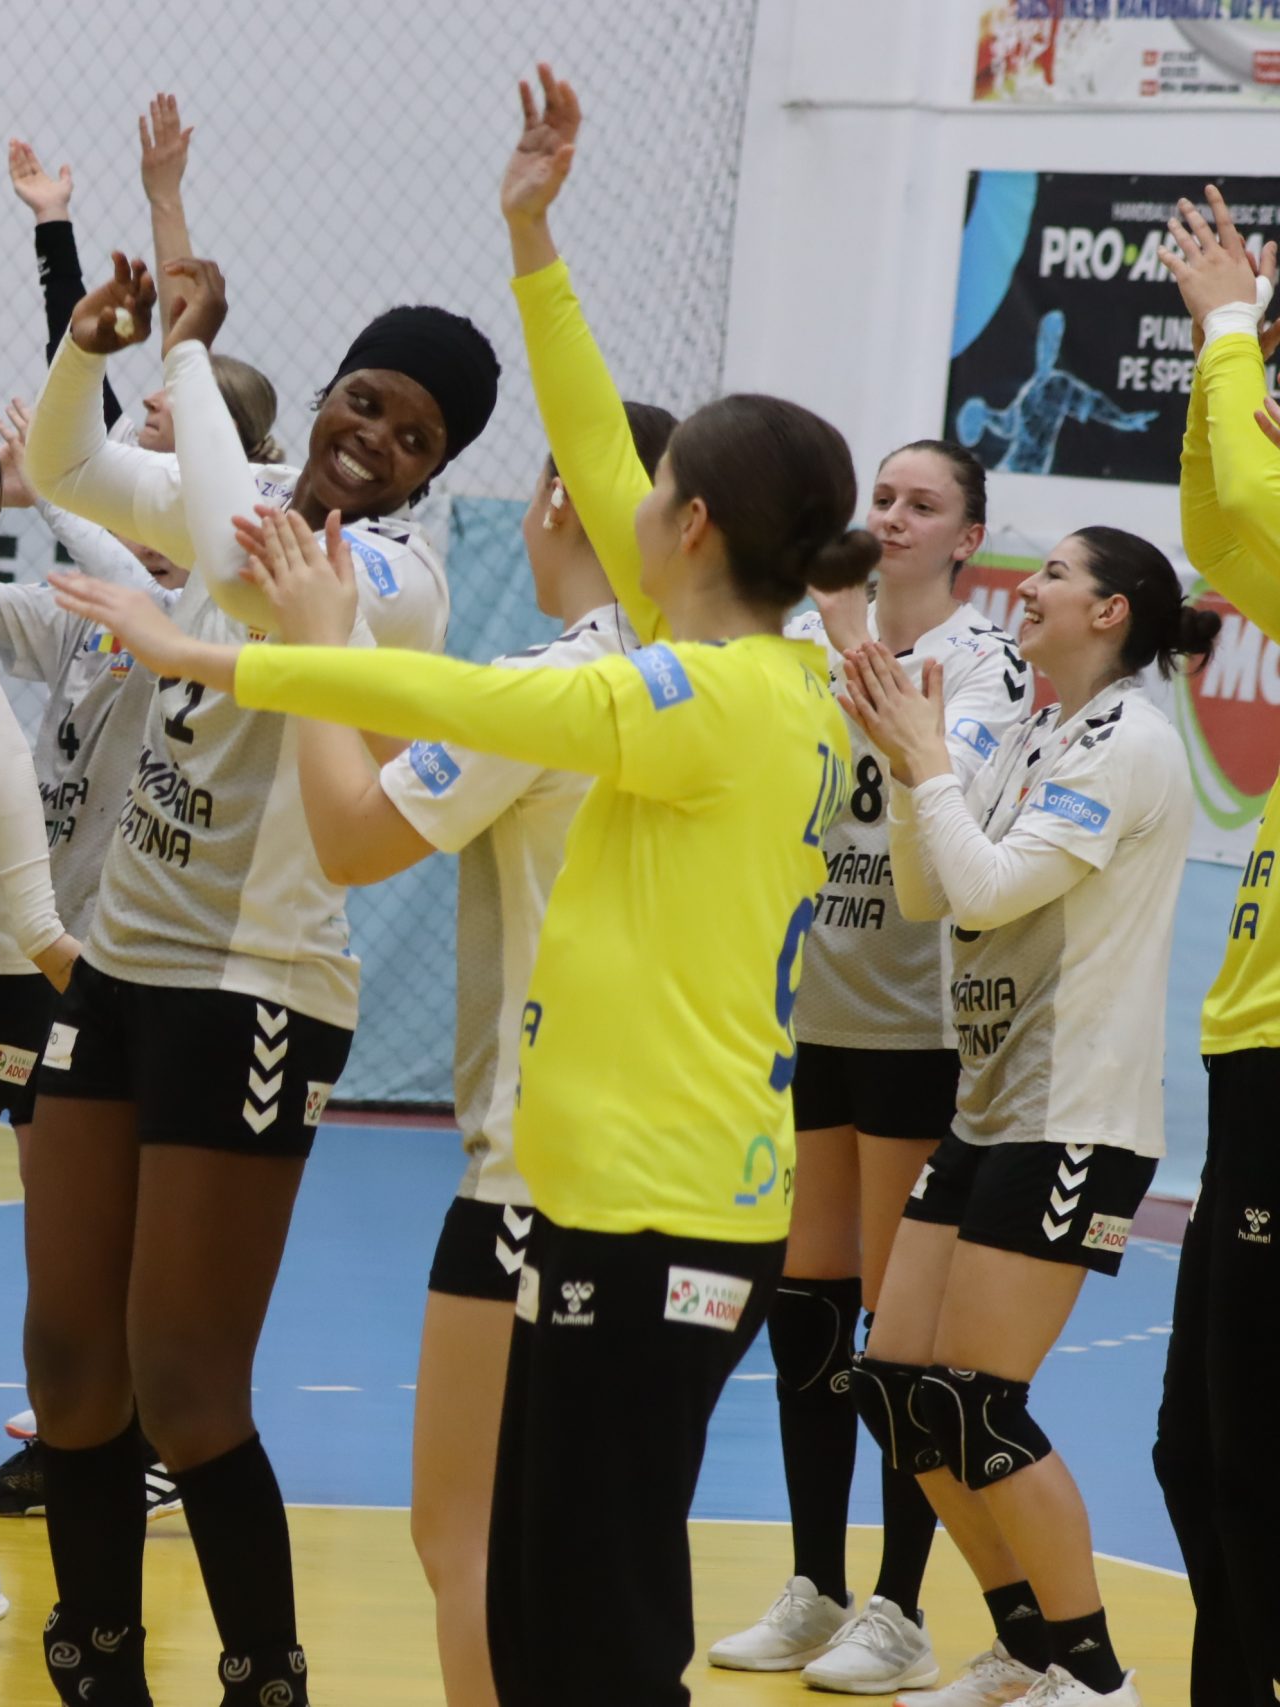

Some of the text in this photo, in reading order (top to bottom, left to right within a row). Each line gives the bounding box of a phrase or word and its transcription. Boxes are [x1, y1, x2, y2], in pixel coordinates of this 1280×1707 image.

[1117, 356, 1149, 391] PE
[851, 755, 883, 823] 8
[1048, 794, 1103, 826] affidea
[1238, 1229, 1272, 1244] hummel
[552, 1309, 595, 1326] hummel
